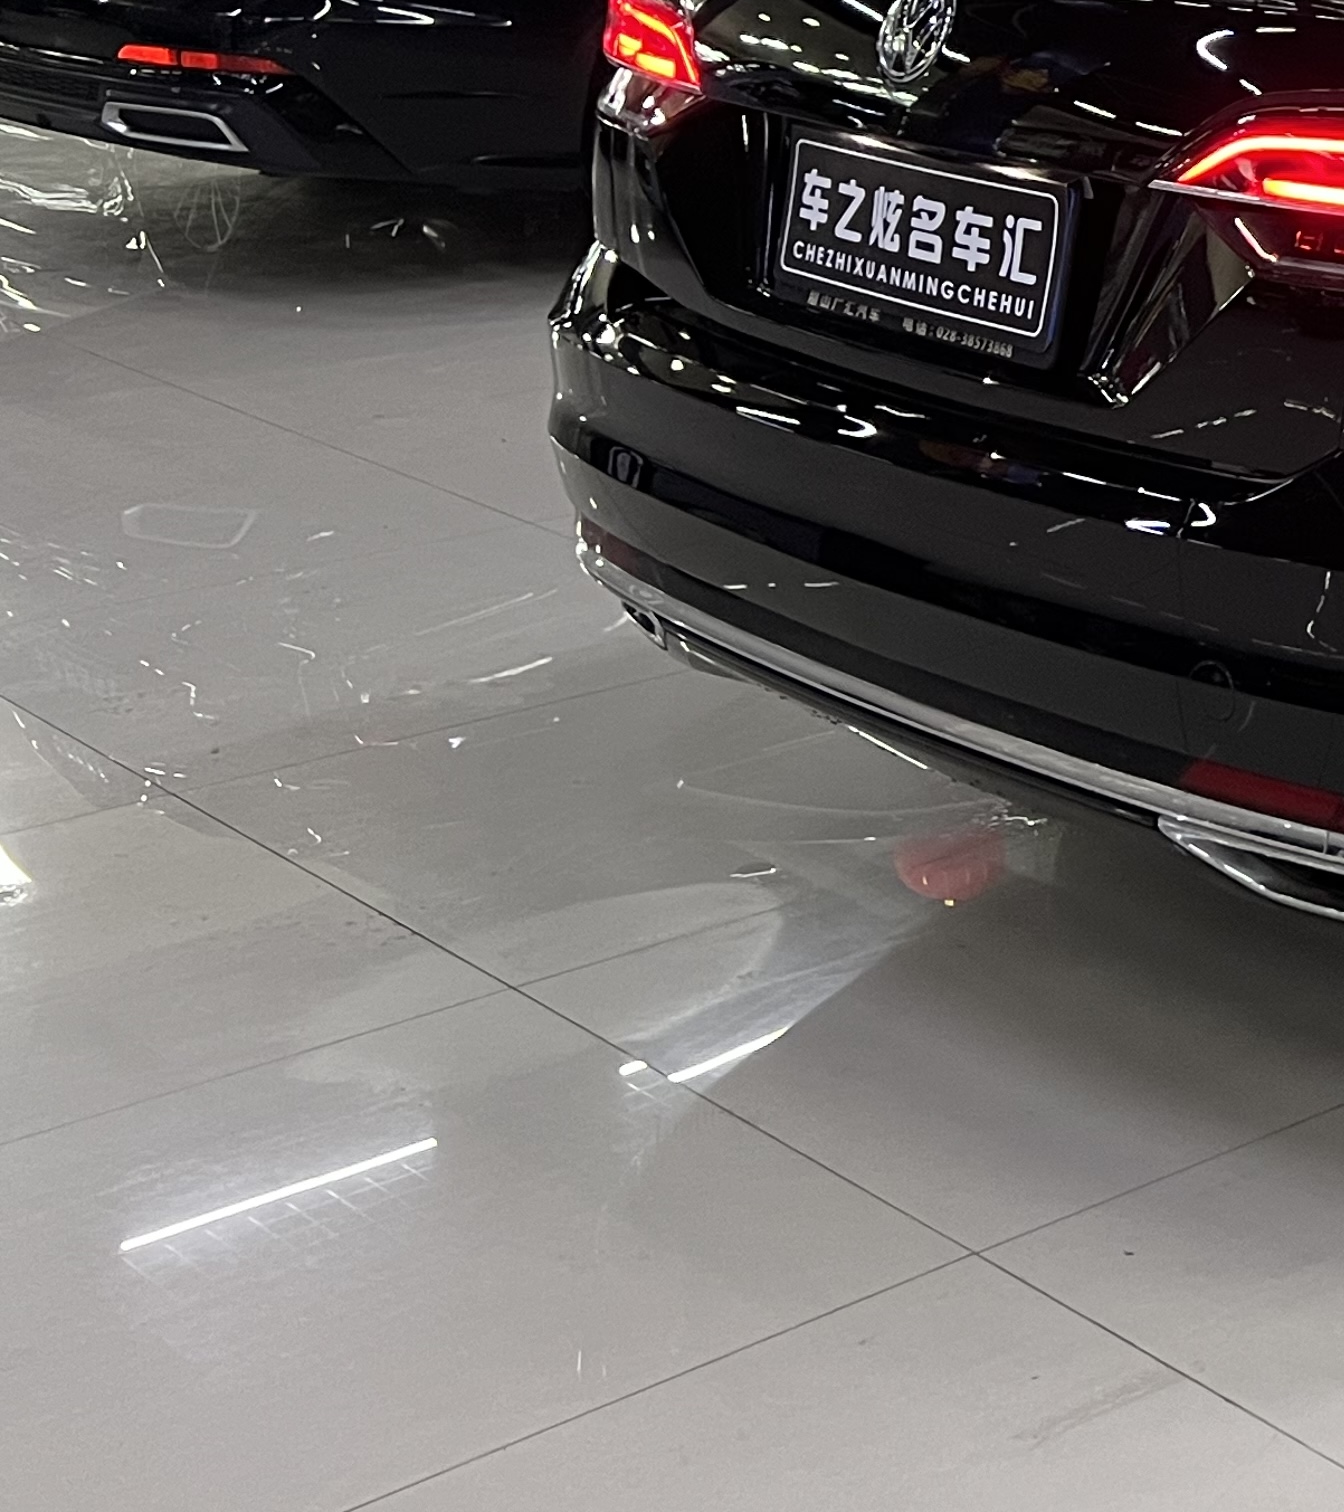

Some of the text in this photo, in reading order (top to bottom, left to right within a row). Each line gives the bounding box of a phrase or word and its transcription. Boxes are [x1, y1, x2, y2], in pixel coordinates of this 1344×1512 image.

[799, 168, 1042, 286] 车之炫名车汇
[792, 240, 1035, 320] CHEZHIXUANMINGCHEHUI
